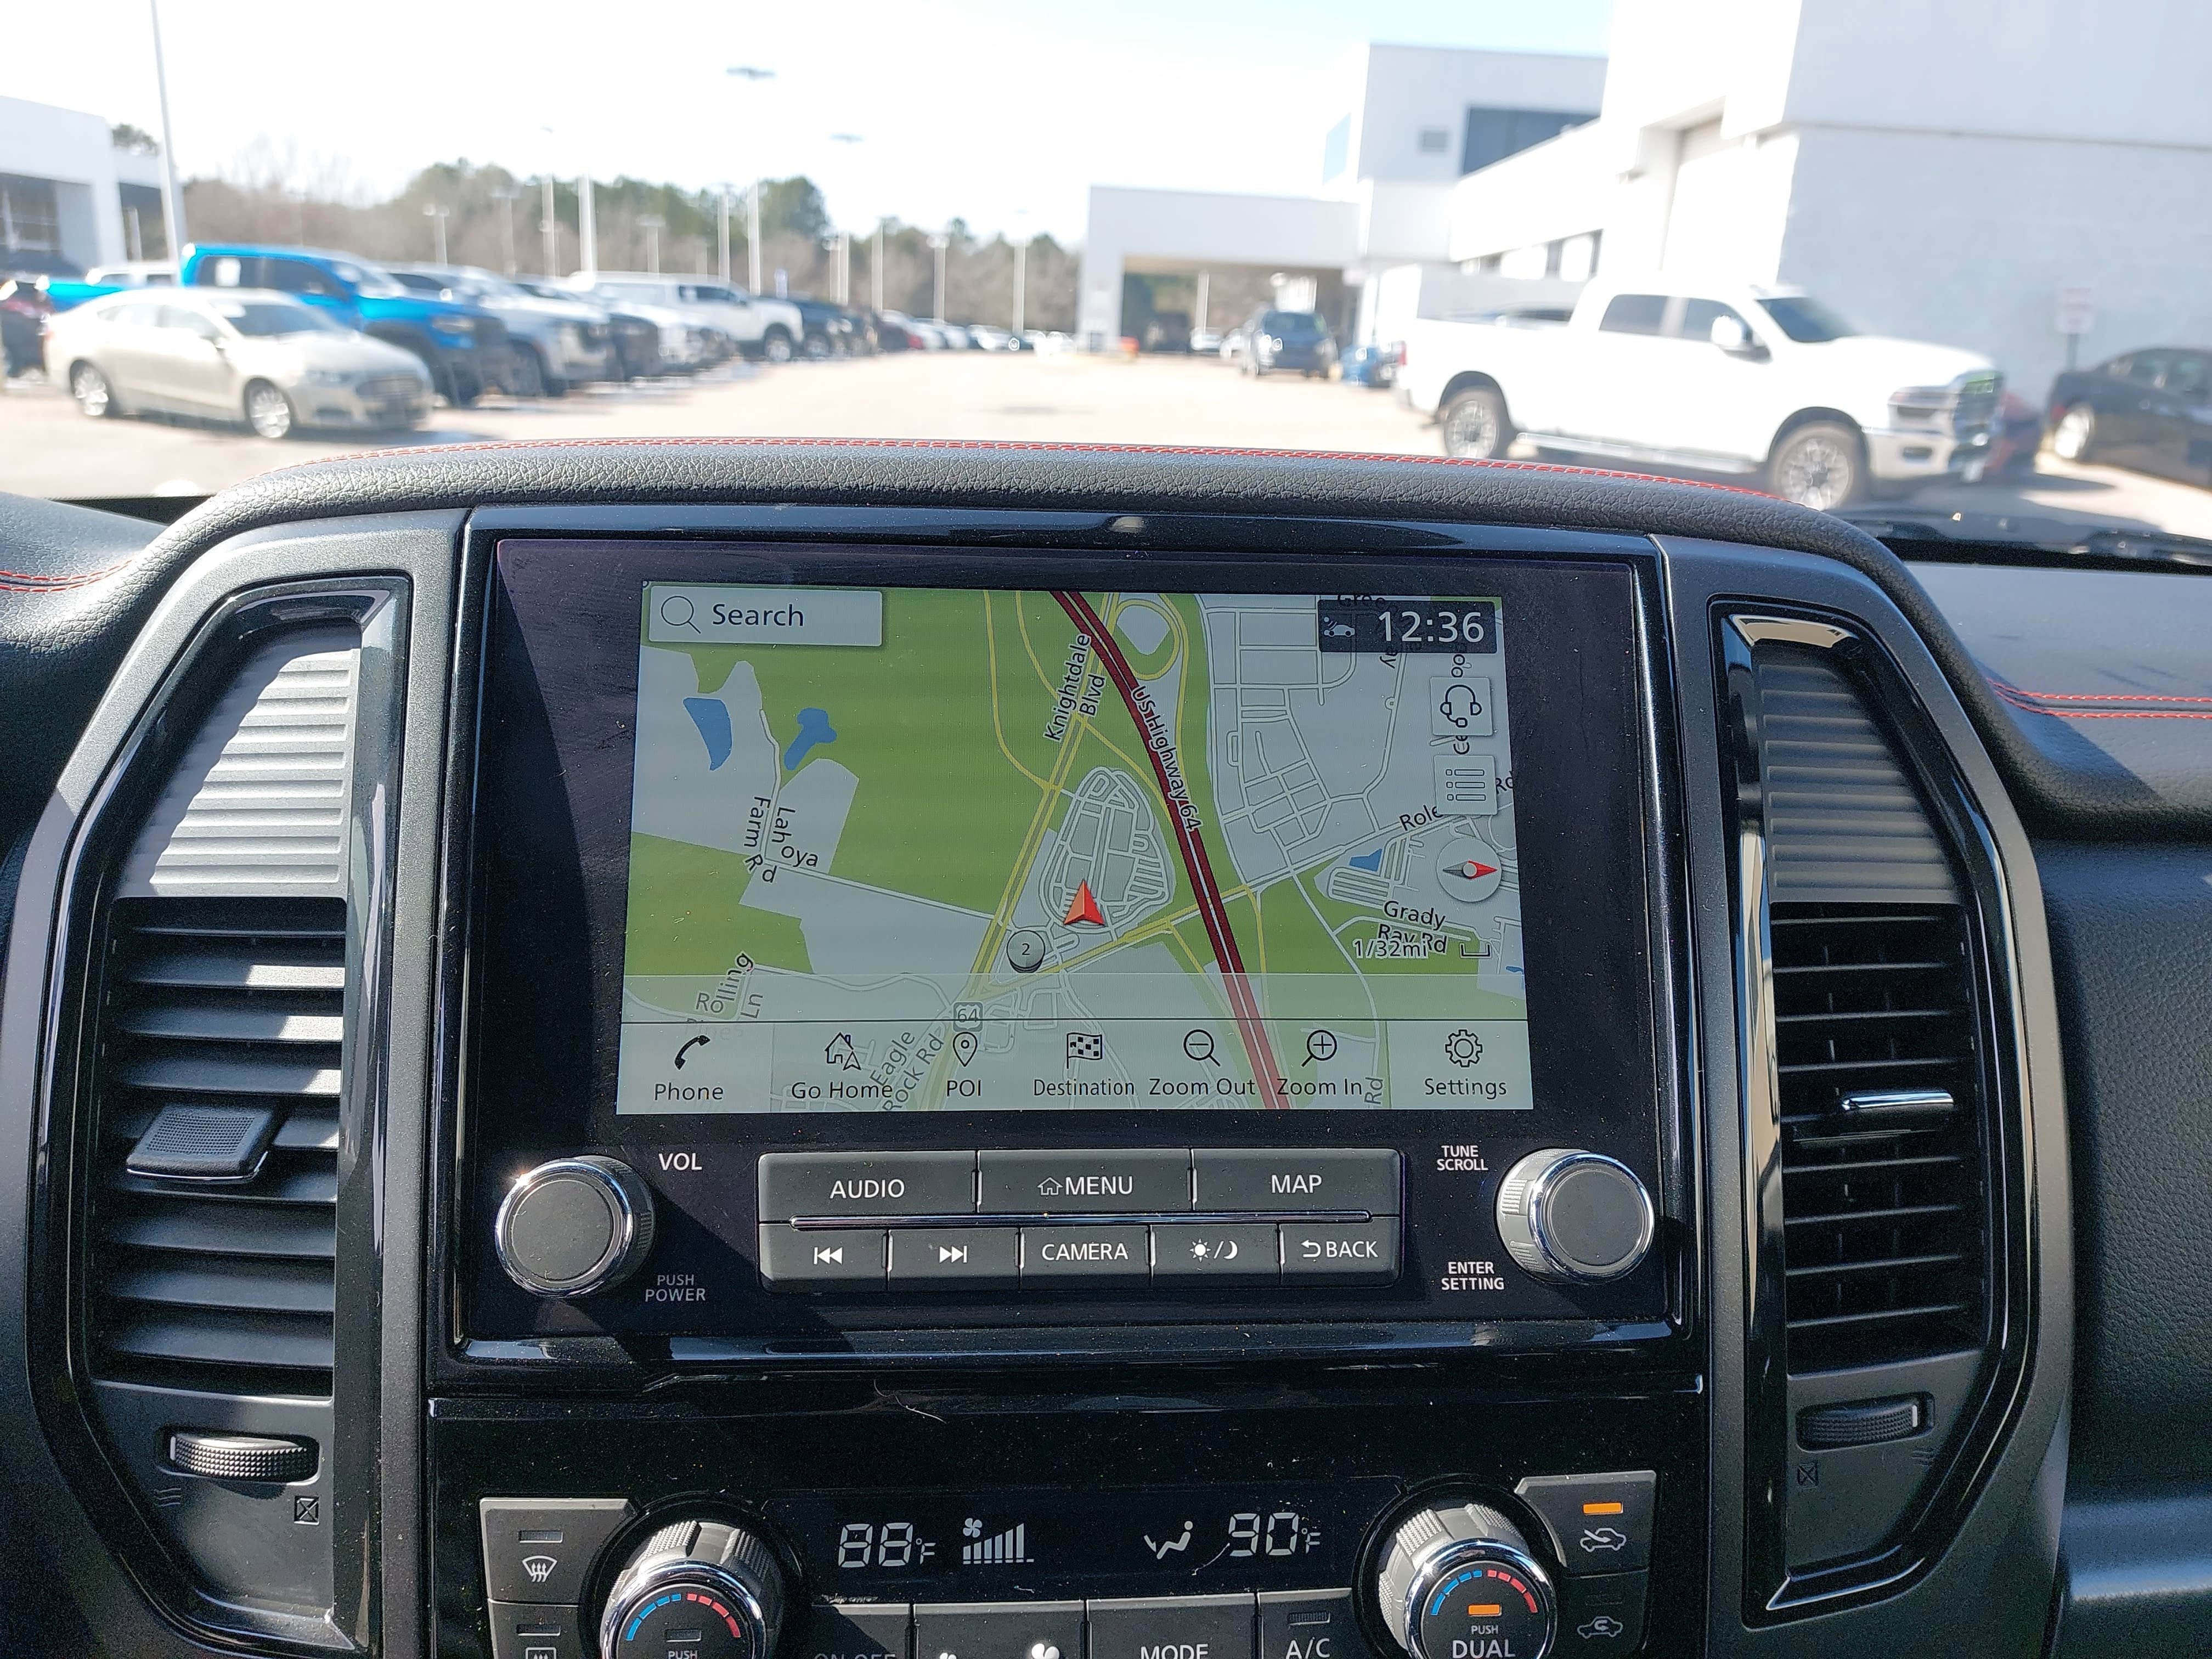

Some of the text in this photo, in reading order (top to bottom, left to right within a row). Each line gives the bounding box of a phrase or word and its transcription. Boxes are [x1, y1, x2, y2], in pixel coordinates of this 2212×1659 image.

[713, 603, 804, 627] Search
[1378, 611, 1485, 643] 12:36
[1044, 634, 1091, 741] Knightdale
[1080, 675, 1105, 716] Blvd
[1132, 686, 1201, 831] US Highway 64
[743, 796, 777, 883] Farm Rd
[1384, 900, 1446, 931] Grady
[1022, 943, 1030, 956] 2
[1354, 940, 1427, 957] 1/32mi
[696, 952, 754, 1013] Rolling
[741, 993, 763, 1019] Ln
[957, 1008, 979, 1023] 64
[870, 1032, 915, 1086] Eagle
[882, 1033, 944, 1111] Rock Rd
[654, 1082, 724, 1101] Phone
[791, 1081, 893, 1099] Go Home
[946, 1080, 981, 1097] POI
[1034, 1078, 1135, 1096] Destination
[1149, 1078, 1255, 1096] Zoom Out
[1277, 1078, 1362, 1095] Zoom In
[1364, 1077, 1384, 1105] Rd
[1425, 1077, 1508, 1099] Settings
[1441, 1145, 1479, 1158] TUNE
[659, 1152, 703, 1171] VOL
[1436, 1159, 1489, 1171] SCROLL
[829, 1178, 905, 1199] AUDIO
[1065, 1176, 1133, 1195] MENU
[1271, 1174, 1322, 1194] MAP
[1041, 1242, 1129, 1261] CAMERA
[1325, 1240, 1378, 1259] BACK
[1448, 1262, 1494, 1274] ENTER
[657, 1274, 695, 1286] PUSH
[1441, 1277, 1504, 1290] SETTING
[645, 1288, 707, 1302] POWER
[1471, 1625, 1499, 1635] PUSH
[668, 1650, 698, 1659] PUSH
[1285, 1637, 1330, 1659] A/C
[1452, 1639, 1516, 1659] DUAL
